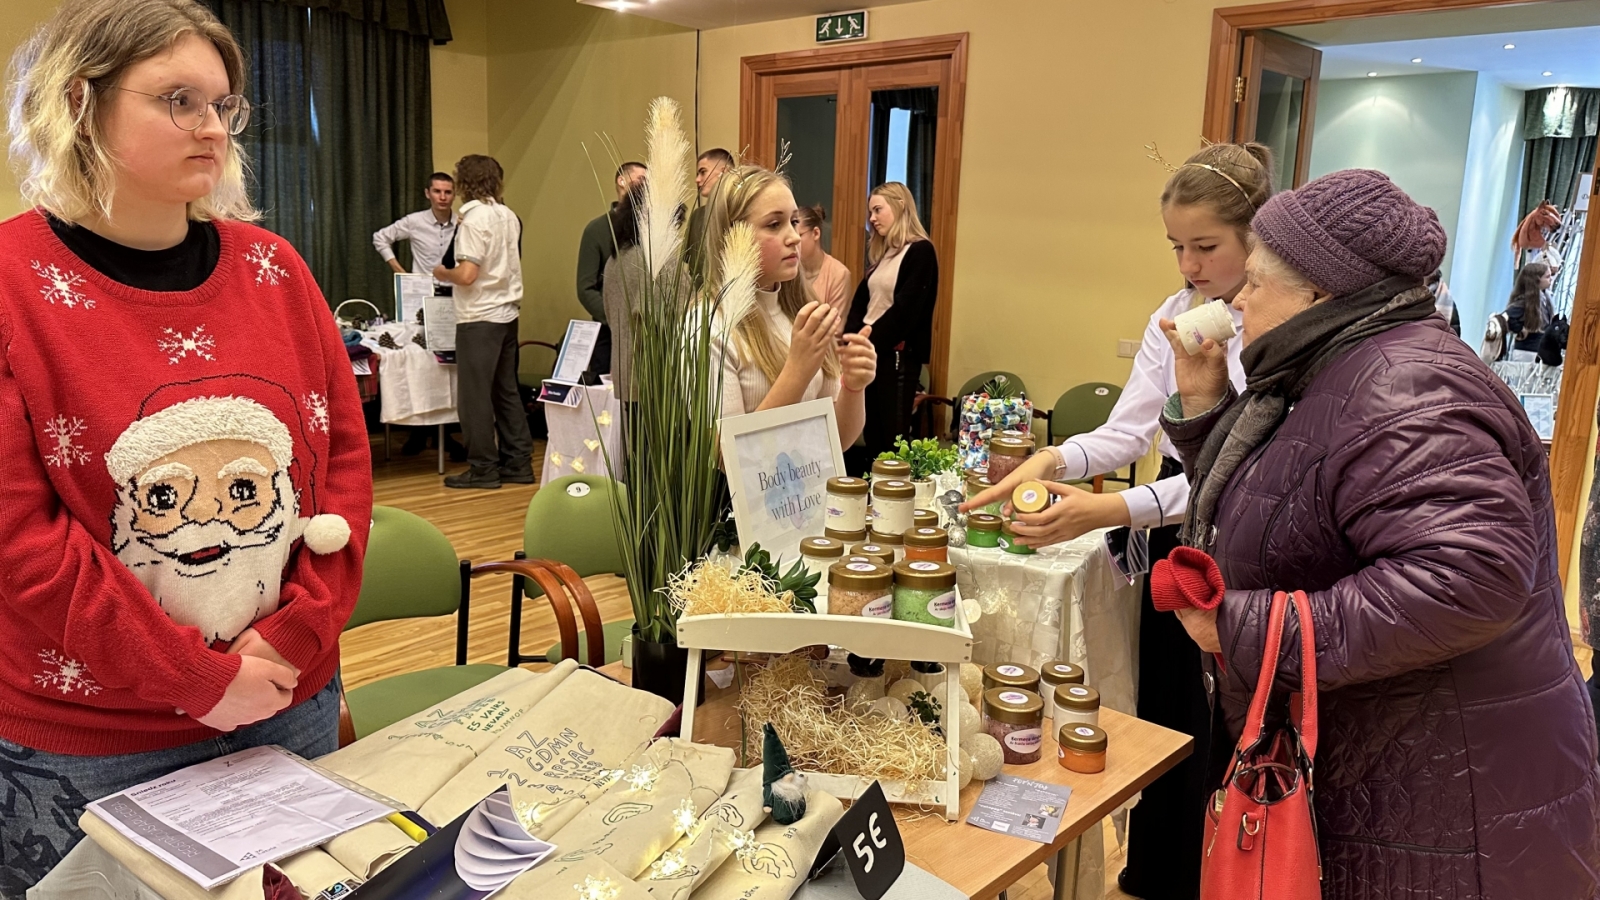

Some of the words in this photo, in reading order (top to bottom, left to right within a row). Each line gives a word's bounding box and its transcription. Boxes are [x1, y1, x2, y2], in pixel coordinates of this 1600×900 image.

[758, 466, 787, 491] Body
[787, 459, 821, 481] beauty
[772, 496, 796, 520] with
[796, 493, 822, 512] Love
[466, 720, 481, 732] ES
[480, 700, 505, 719] VAIRS
[481, 706, 511, 732] NEVARU
[505, 729, 549, 760] AZ
[526, 727, 579, 772] GDMN
